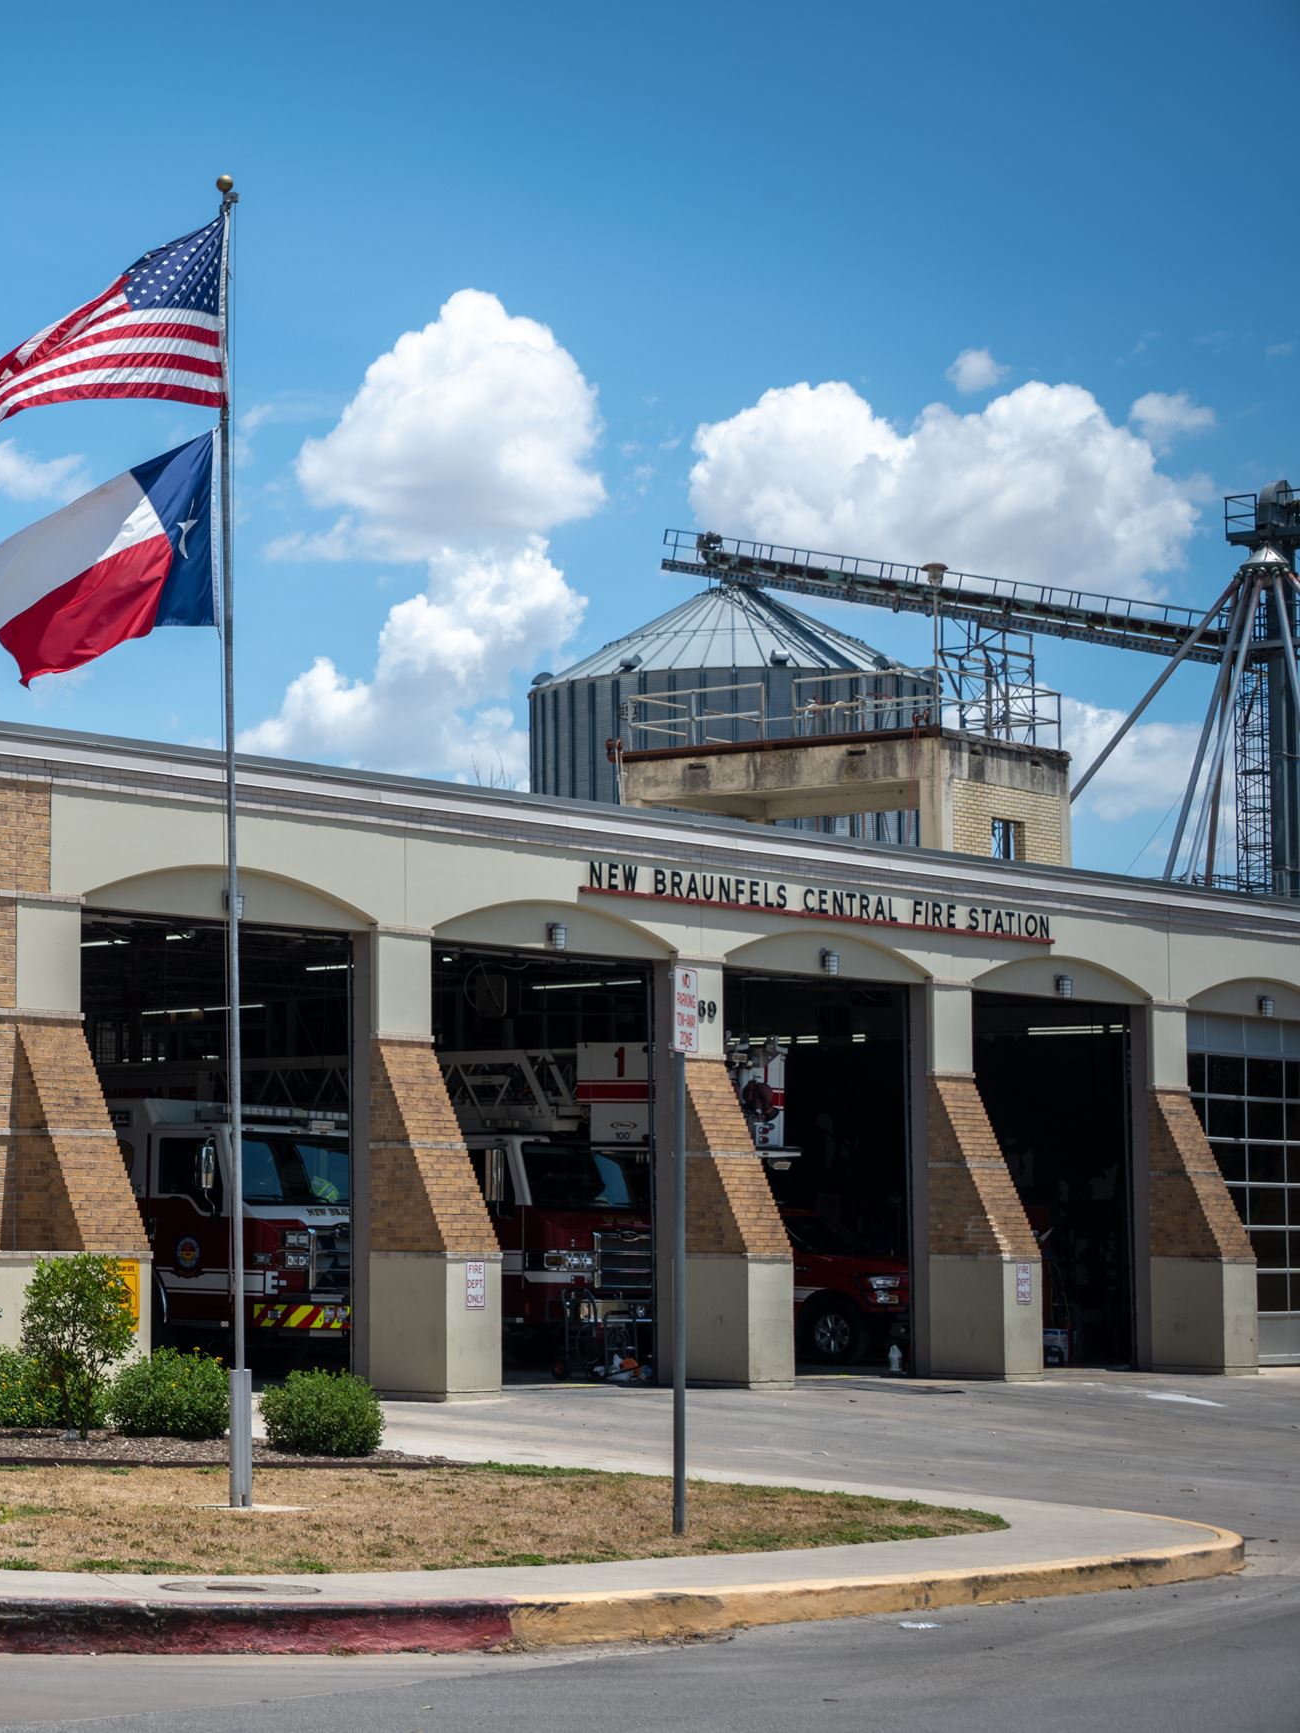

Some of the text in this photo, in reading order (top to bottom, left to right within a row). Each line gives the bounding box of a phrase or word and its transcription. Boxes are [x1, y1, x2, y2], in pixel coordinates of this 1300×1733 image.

[589, 861, 1050, 938] NEW BRAUNFELS CENTRAL FIRE STATION
[682, 973, 690, 988] NO
[677, 992, 695, 1008] PARKING
[677, 1012, 695, 1028] TOW-AWAY
[680, 1031, 692, 1046] ZONE
[614, 1046, 625, 1077] 1
[306, 1208, 350, 1216] NEW BRAU
[468, 1264, 482, 1274] FIRE
[1019, 1265, 1028, 1274] FIRE
[467, 1294, 483, 1303] ONLY
[1018, 1291, 1030, 1299] ONLY
